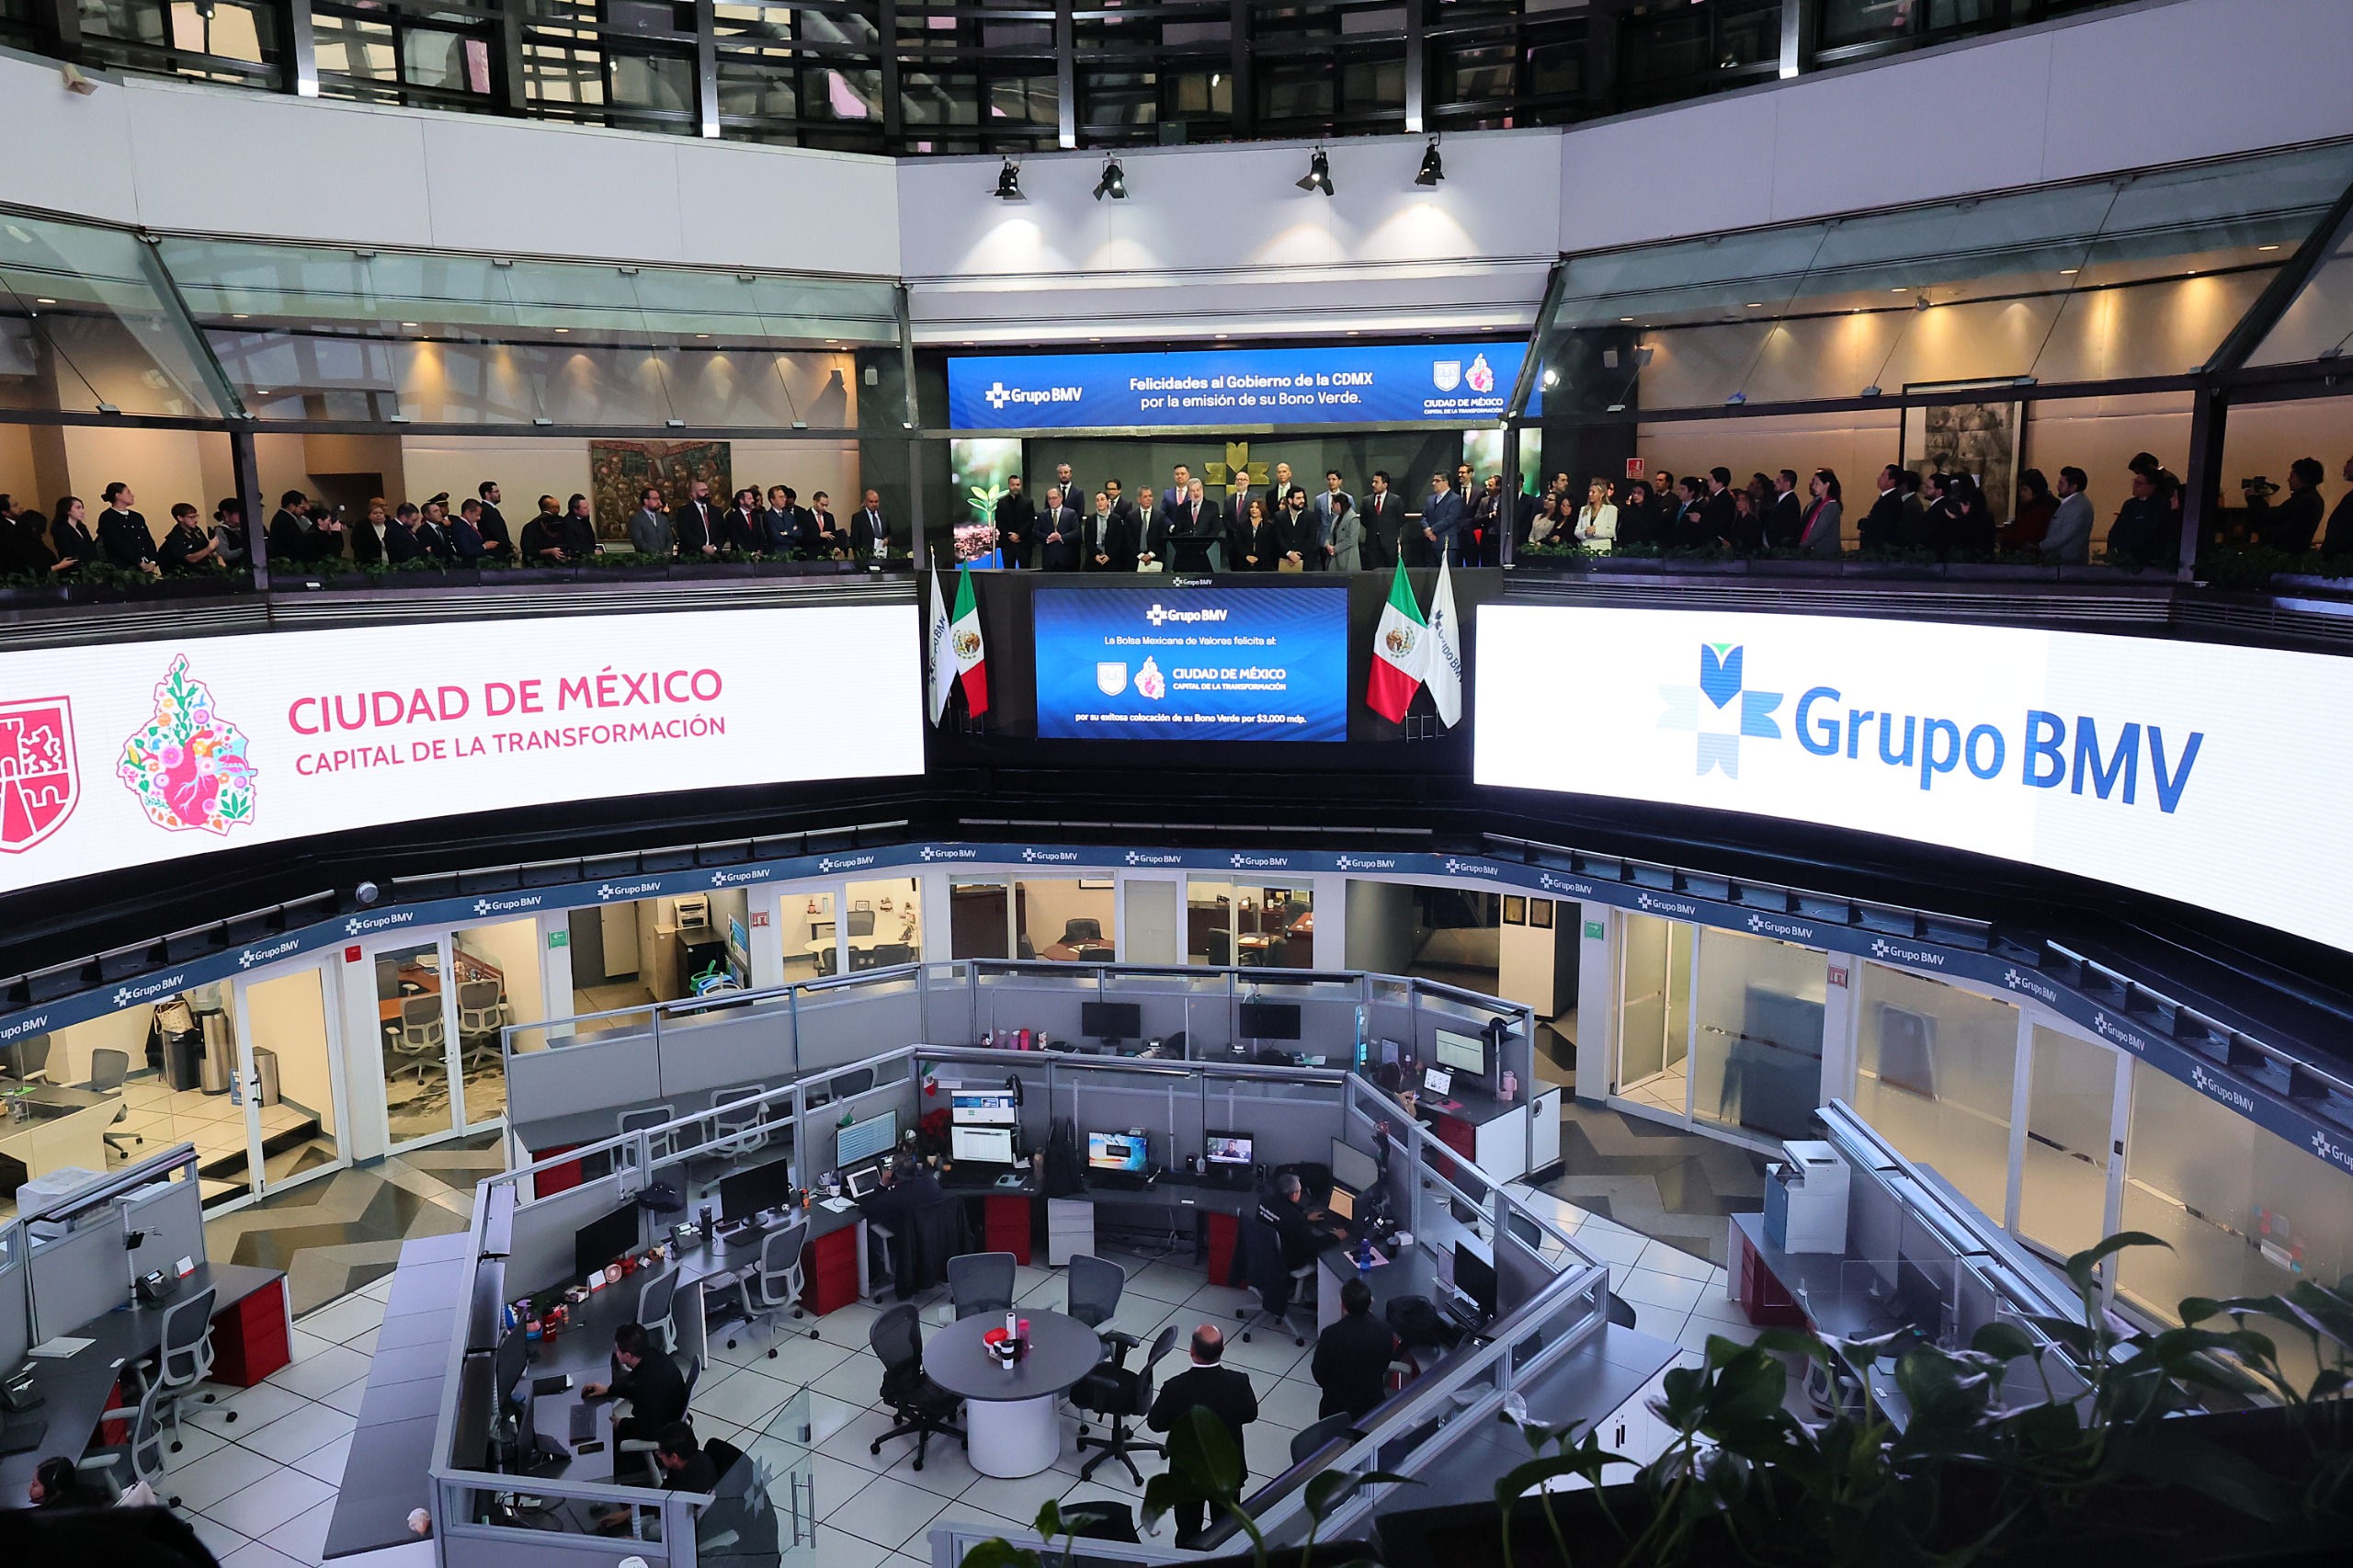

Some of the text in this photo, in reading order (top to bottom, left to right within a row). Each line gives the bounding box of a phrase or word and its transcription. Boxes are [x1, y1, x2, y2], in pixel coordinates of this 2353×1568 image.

[1130, 372, 1373, 391] Felicidades al Gobierno de la CDMX
[1011, 387, 1083, 405] Grupo BMV
[1141, 391, 1362, 411] por la emisión de su Bono Verde.
[1424, 397, 1505, 408] CIUDAD DE MÉXICO
[1183, 578, 1199, 586] Grupo
[1168, 609, 1228, 623] Grupo BMV
[1105, 636, 1278, 645] La Bolsa Mexicana de Valores felicita al:
[1172, 665, 1287, 680] CIUDAD DE MÉXICO
[1222, 682, 1287, 690] TRANSFORMACIÓN
[289, 666, 722, 734] CIUDAD DE MÉXICO
[1075, 714, 1089, 722] por
[1090, 713, 1099, 722] su
[1100, 713, 1128, 722] exitosa
[1130, 712, 1171, 722] colocación
[1172, 713, 1182, 722] de
[1195, 714, 1216, 722] Bono
[1217, 714, 1240, 723] Verde
[1242, 716, 1255, 724] por
[1256, 713, 1285, 724] $3,000
[1287, 714, 1307, 724] mdp.
[296, 713, 724, 775] CAPITAL DE LA TRANSFORMACIÓN
[1796, 687, 2204, 813] Grupo BMV
[936, 849, 975, 859] Grupo BMV
[1037, 851, 1077, 861] Grupo BMV
[1141, 854, 1181, 865] Grupo BMV
[834, 855, 874, 869] Grupo BMV
[1245, 857, 1288, 868] Grupo BMV
[1352, 858, 1394, 869] Grupo BMV
[1461, 863, 1498, 876] Grupo BMV
[727, 868, 769, 882] Grupo BMV
[615, 881, 660, 895] Grupo BMV
[1554, 880, 1592, 894] Grupo BMV
[493, 895, 541, 911] Grupo BMV
[1654, 899, 1695, 915] Grupo BMV
[363, 912, 413, 929] Grupo BMV
[1765, 922, 1812, 938] Grupo BMV
[256, 938, 299, 960] Grupo BMV
[1891, 947, 1944, 966] Grupo BMV
[133, 973, 183, 998] Grupo BMV
[2021, 978, 2057, 1003] Grupo BMV
[0, 1015, 47, 1040] upo BMV
[2108, 1023, 2144, 1051] Grupo BMV
[2208, 1079, 2253, 1112] Grupo BMV
